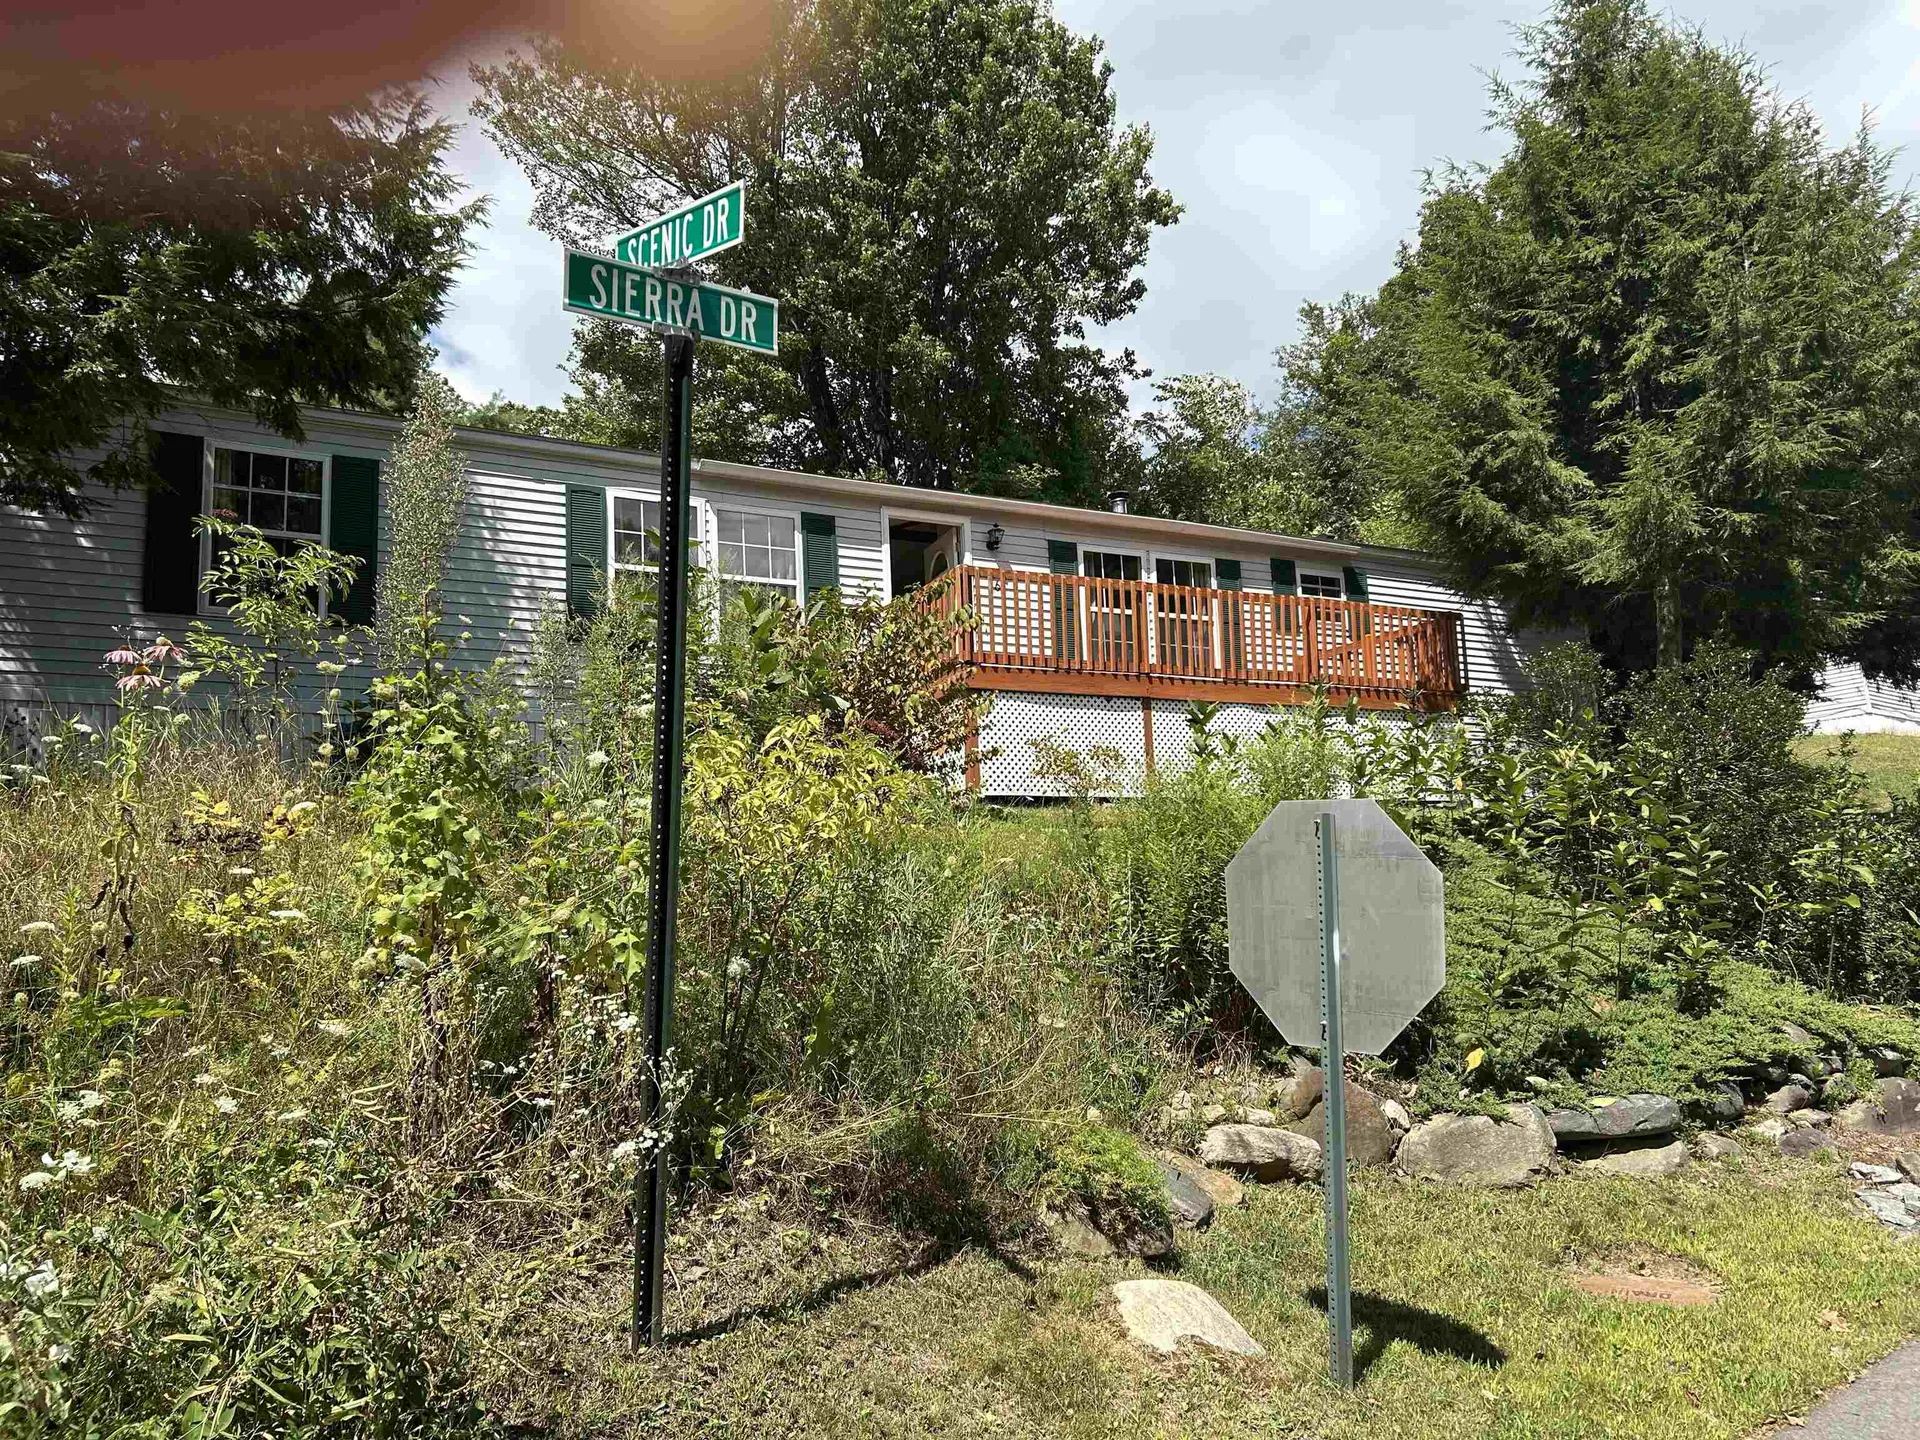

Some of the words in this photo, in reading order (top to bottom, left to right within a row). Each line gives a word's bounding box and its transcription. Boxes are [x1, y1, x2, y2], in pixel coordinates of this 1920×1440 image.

[628, 213, 693, 267] SCENIC
[703, 198, 729, 249] DR
[590, 264, 704, 331] SIERRA
[720, 296, 757, 343] DR
